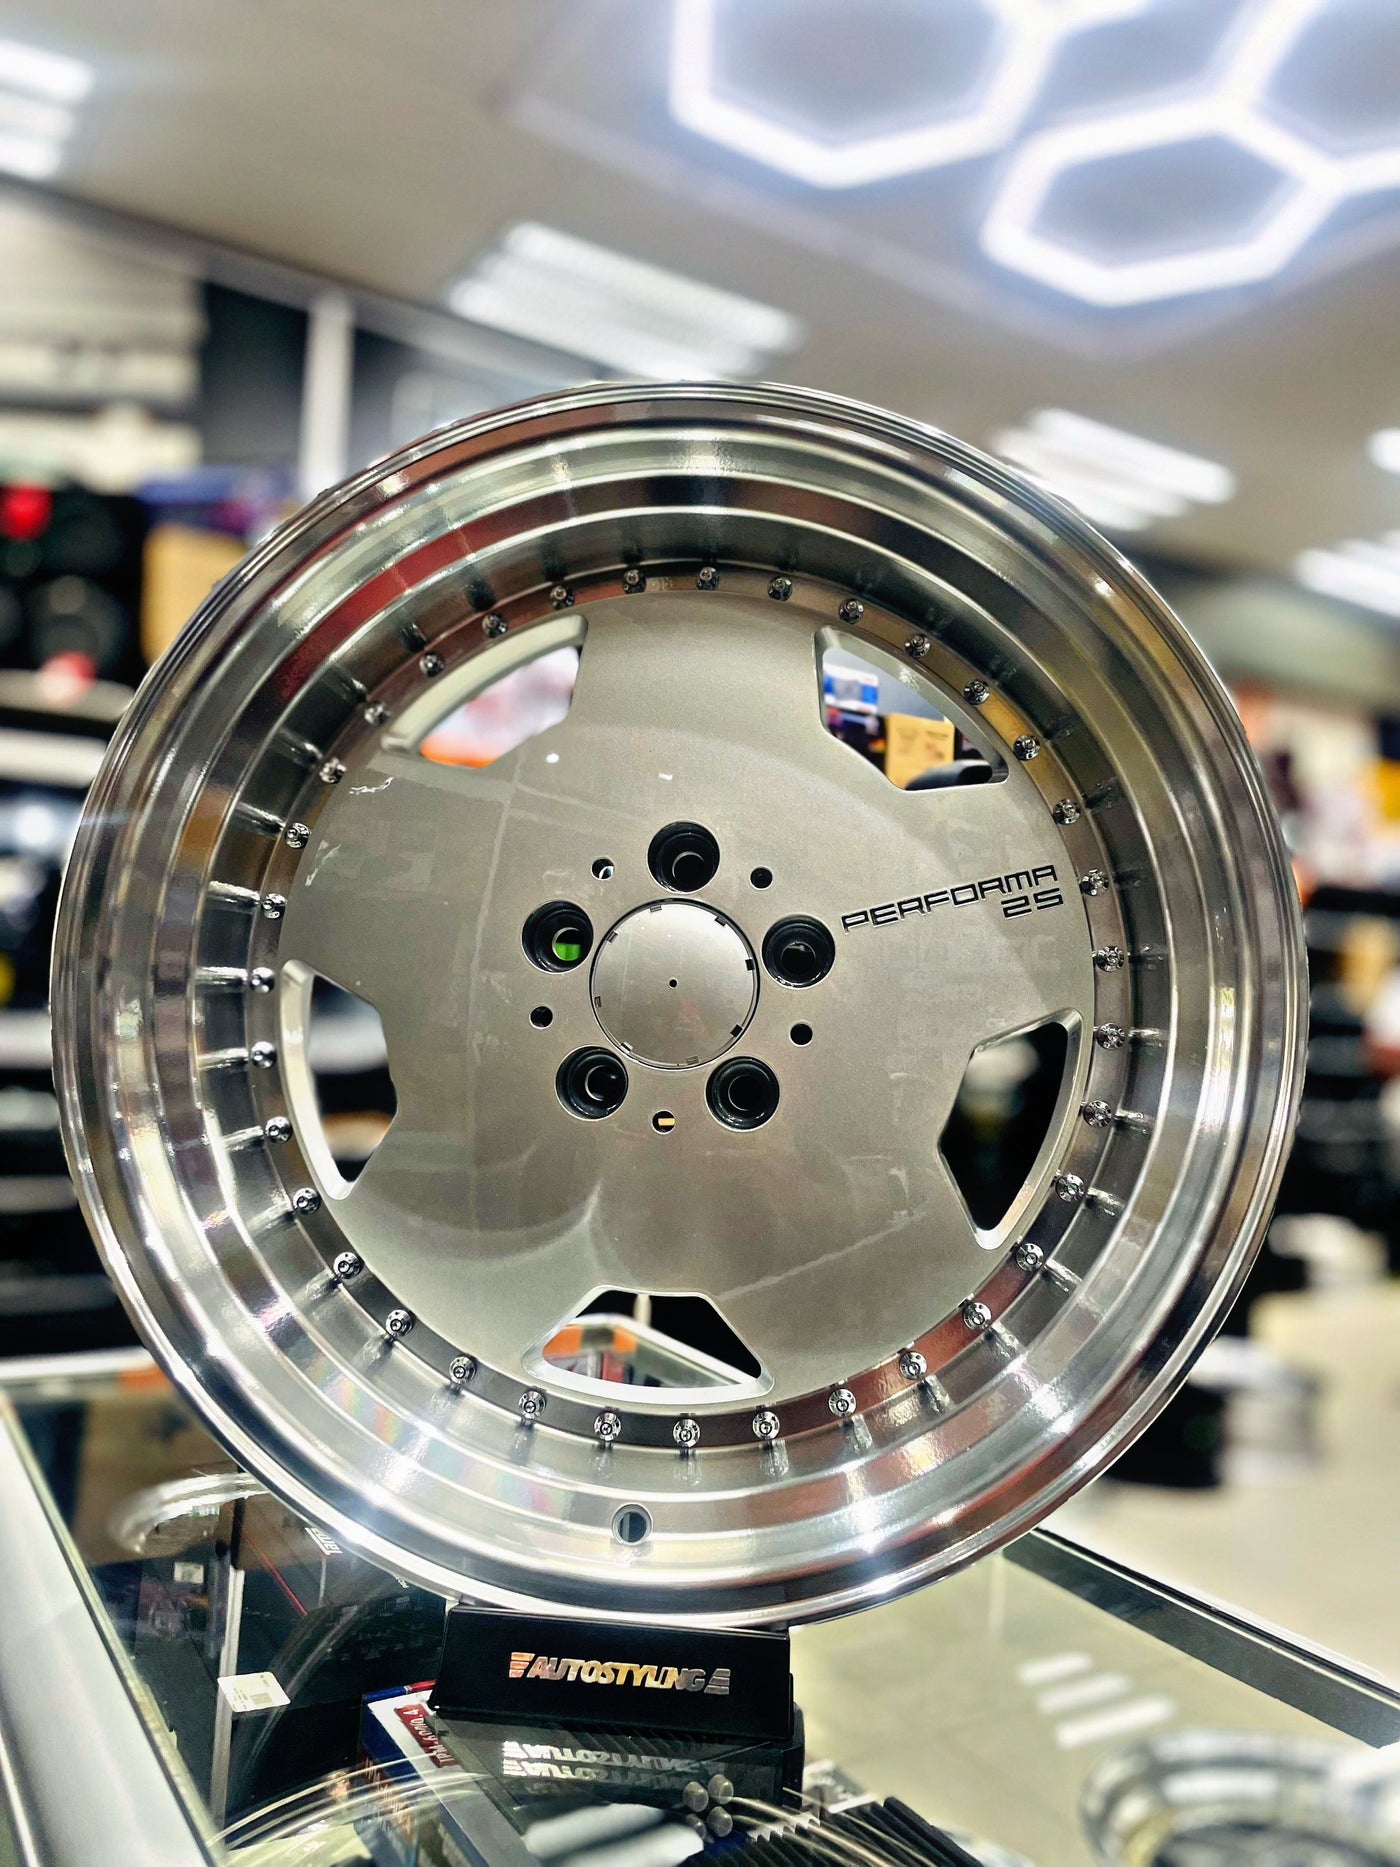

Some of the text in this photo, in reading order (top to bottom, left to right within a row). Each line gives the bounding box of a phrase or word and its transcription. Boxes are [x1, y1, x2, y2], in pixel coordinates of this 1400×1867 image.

[841, 865, 1057, 932] PERFORMA
[1001, 888, 1063, 918] 25
[527, 1656, 706, 1691] AUTOSTYLING
